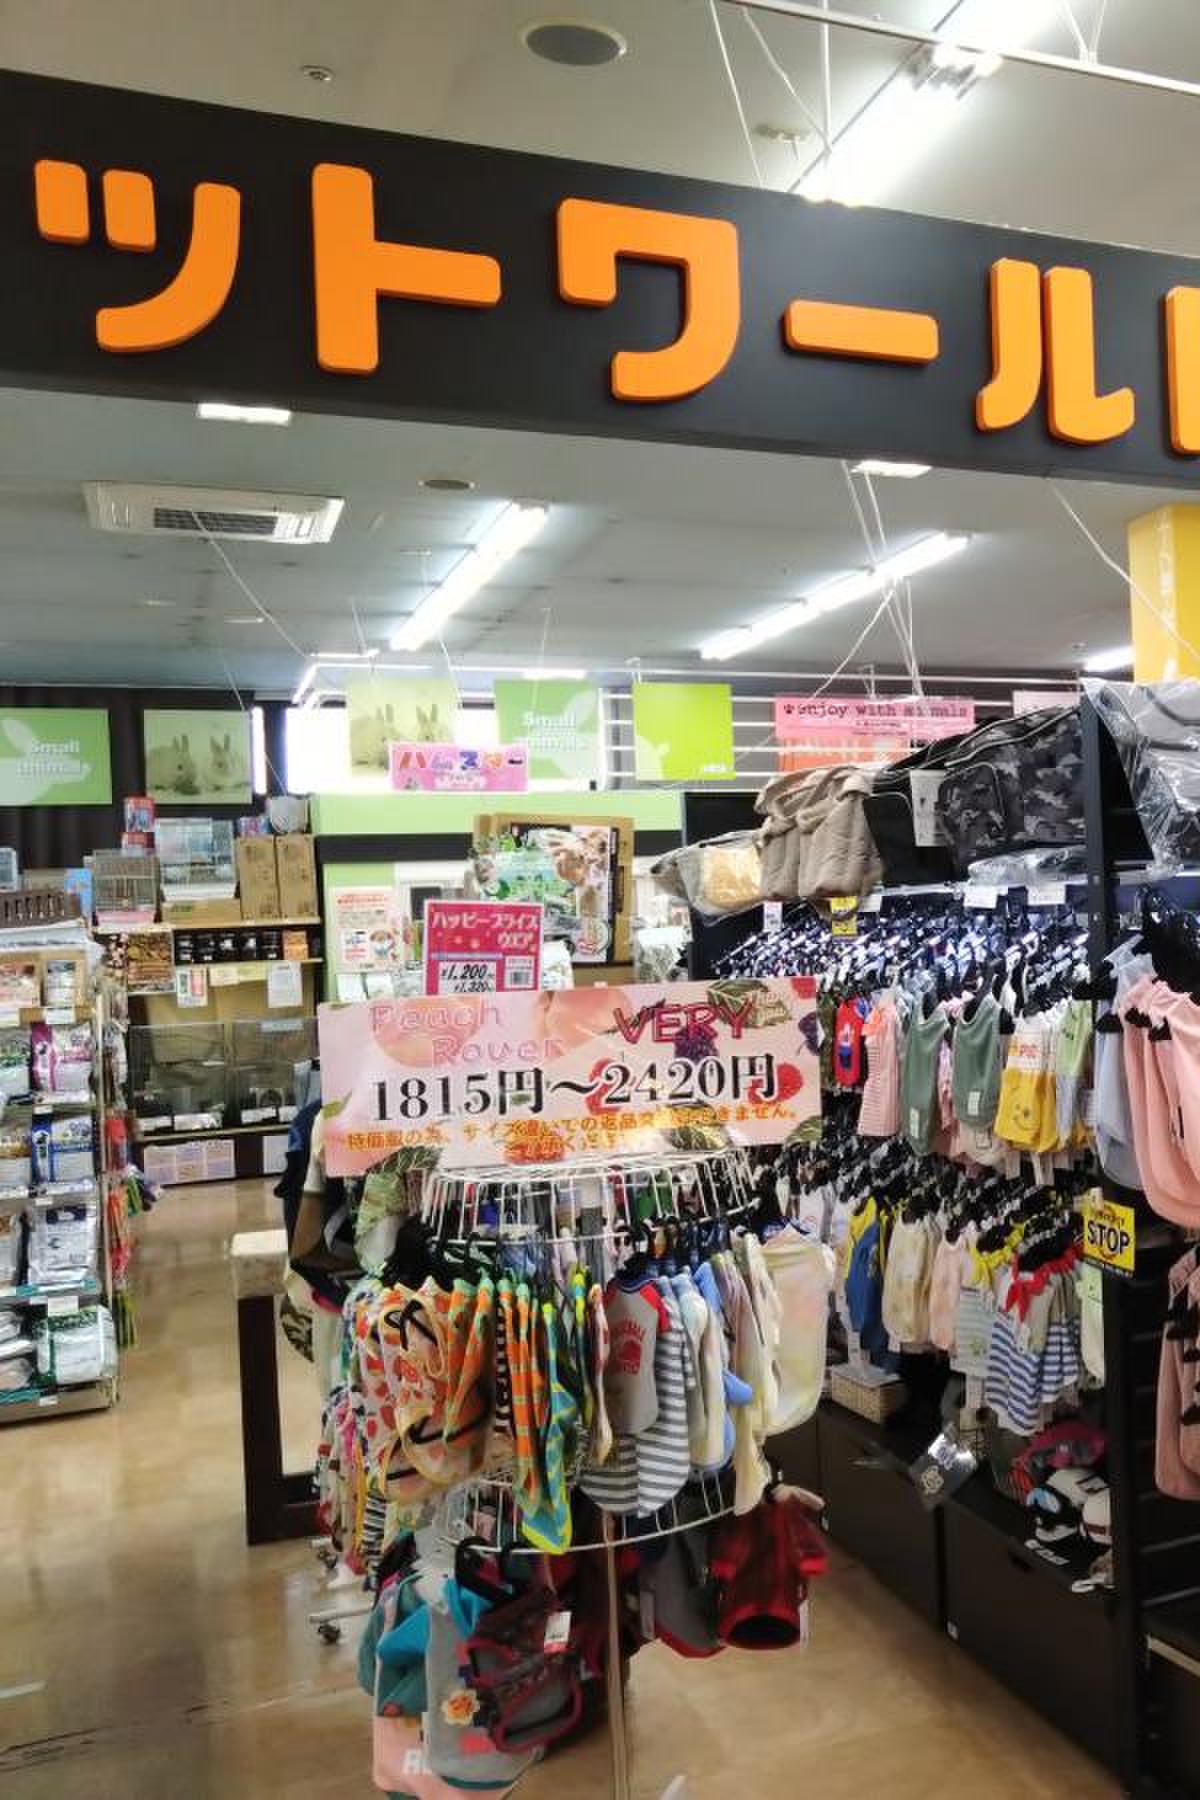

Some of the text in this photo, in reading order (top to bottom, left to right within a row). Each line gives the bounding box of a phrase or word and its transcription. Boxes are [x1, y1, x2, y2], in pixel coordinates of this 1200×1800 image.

[432, 911, 539, 928] ハッピープライス
[613, 997, 756, 1044] VERY
[1086, 1220, 1130, 1254] STOP
